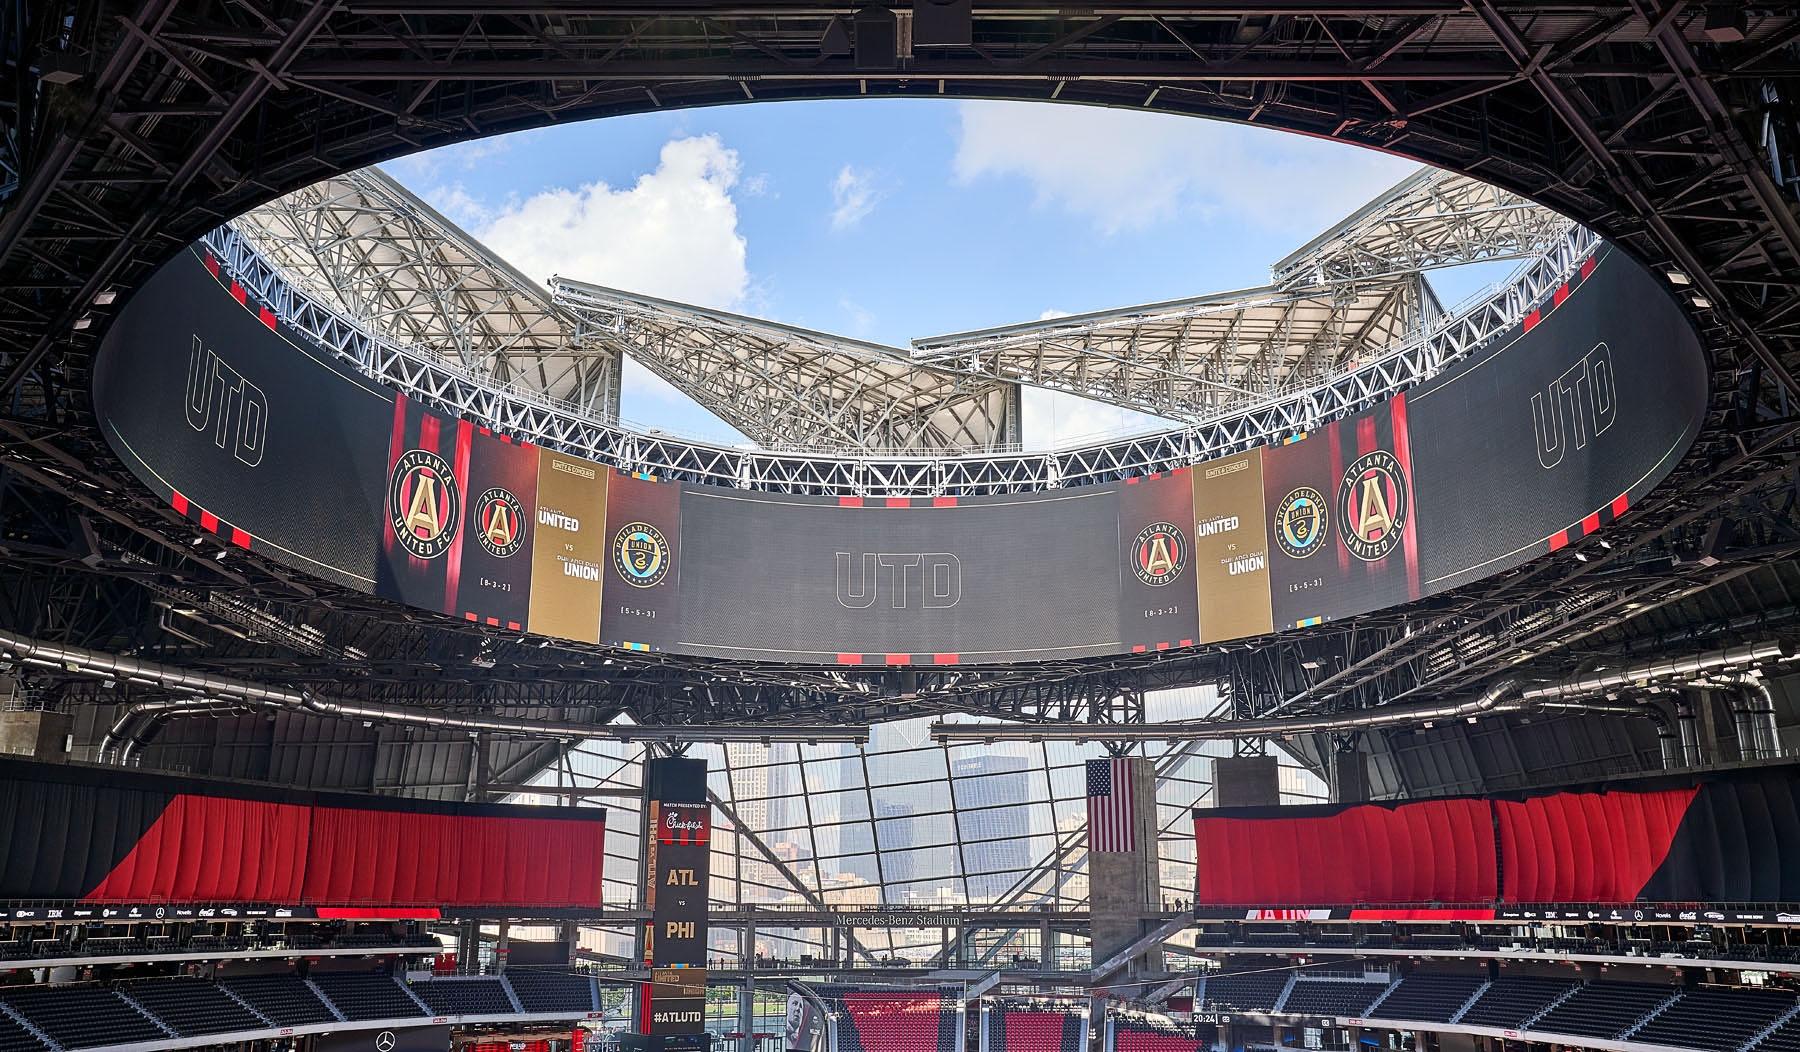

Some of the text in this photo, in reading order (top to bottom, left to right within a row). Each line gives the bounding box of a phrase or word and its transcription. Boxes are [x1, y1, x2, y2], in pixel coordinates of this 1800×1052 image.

[185, 333, 269, 467] UTD
[1530, 341, 1617, 469] UTD
[403, 454, 452, 486] ATLANTA
[1345, 454, 1394, 488] ATLANTA
[406, 473, 441, 539] A
[484, 491, 519, 511] ATLANTA
[1277, 490, 1325, 525] PHILADELPHIA
[1359, 476, 1393, 541] A
[538, 510, 579, 532] UNITED
[1290, 507, 1311, 520] UNION
[395, 517, 451, 554] UNITED FC
[1139, 525, 1178, 543] ATLANTA
[1198, 516, 1239, 537] UNITED
[479, 532, 519, 555] UNITED FC
[616, 524, 667, 555] PHILADELPHIA
[631, 540, 652, 551] UNION
[1347, 520, 1403, 556] UNITED FC
[564, 561, 599, 581] UNION
[1138, 563, 1182, 584] UNITED FC
[1229, 556, 1265, 575] UNION
[835, 551, 962, 609] UTD
[666, 869, 699, 886] ATL
[666, 922, 695, 939] PHI
[836, 914, 960, 926] Mercedes-Benz Stadium
[654, 1011, 701, 1023] #ATLUTD
[1193, 1013, 1215, 1024] 20:24
